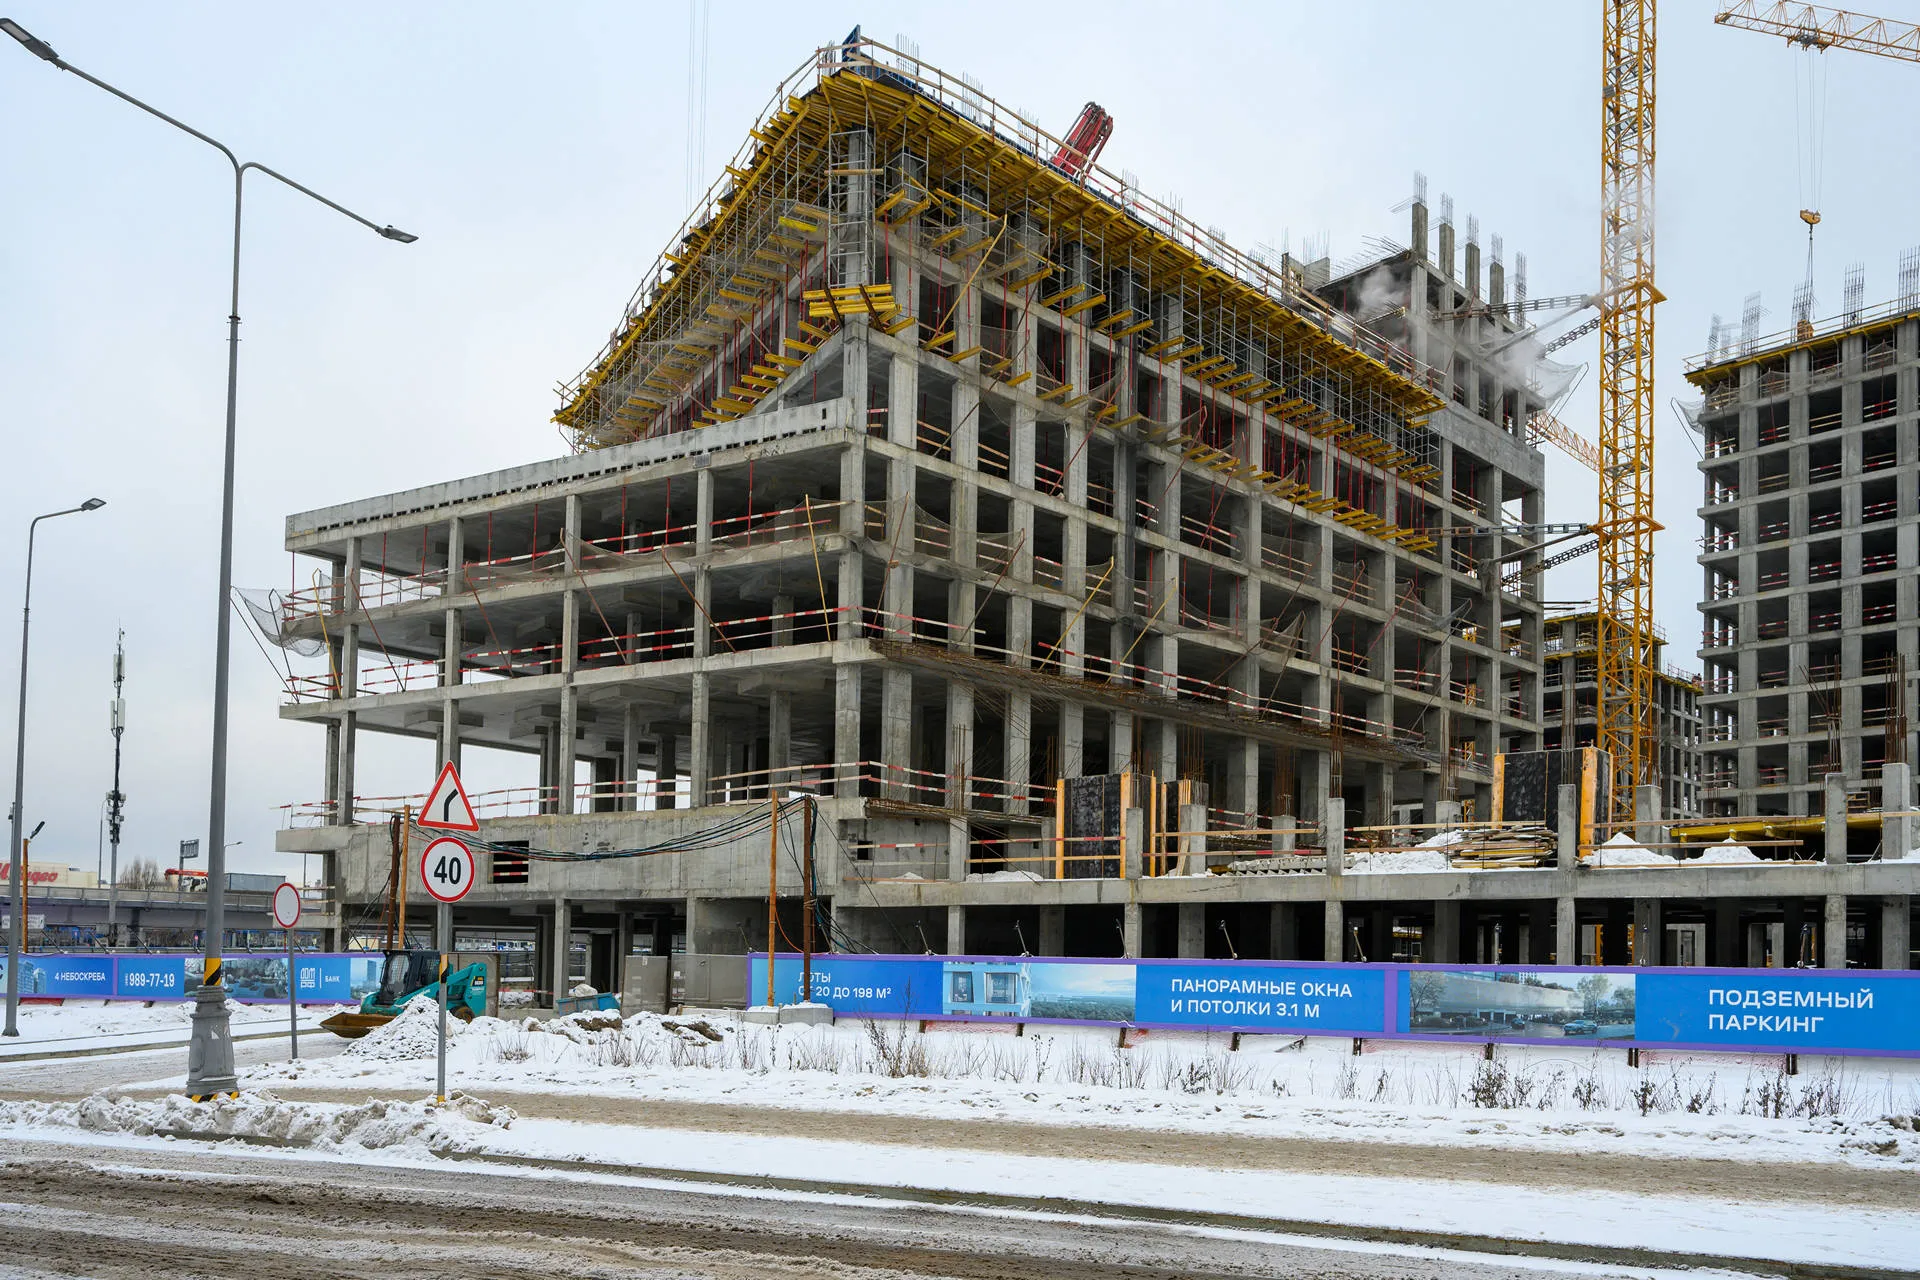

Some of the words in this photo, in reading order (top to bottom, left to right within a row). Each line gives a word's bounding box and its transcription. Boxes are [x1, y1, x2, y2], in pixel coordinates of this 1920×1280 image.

[434, 856, 461, 884] 40
[61, 972, 106, 982] НЕБОСКРЕБА
[129, 973, 175, 987] 989-77-19
[324, 975, 340, 983] БАНК
[815, 986, 830, 997] 20
[833, 987, 850, 999] ДО
[853, 988, 873, 998] 198
[876, 988, 892, 999] М²
[1171, 979, 1296, 996] ПАНОРАМНЫЕ
[1301, 983, 1353, 998] ОКНА
[1709, 988, 1874, 1009] ПОДЗЕМНЫЙ
[1171, 1000, 1183, 1014] И
[1187, 1000, 1271, 1016] ПОТОЛКИ
[1276, 1003, 1298, 1017] 3.1
[1304, 1004, 1320, 1018] М
[1709, 1014, 1824, 1033] ПАРКИНГ
